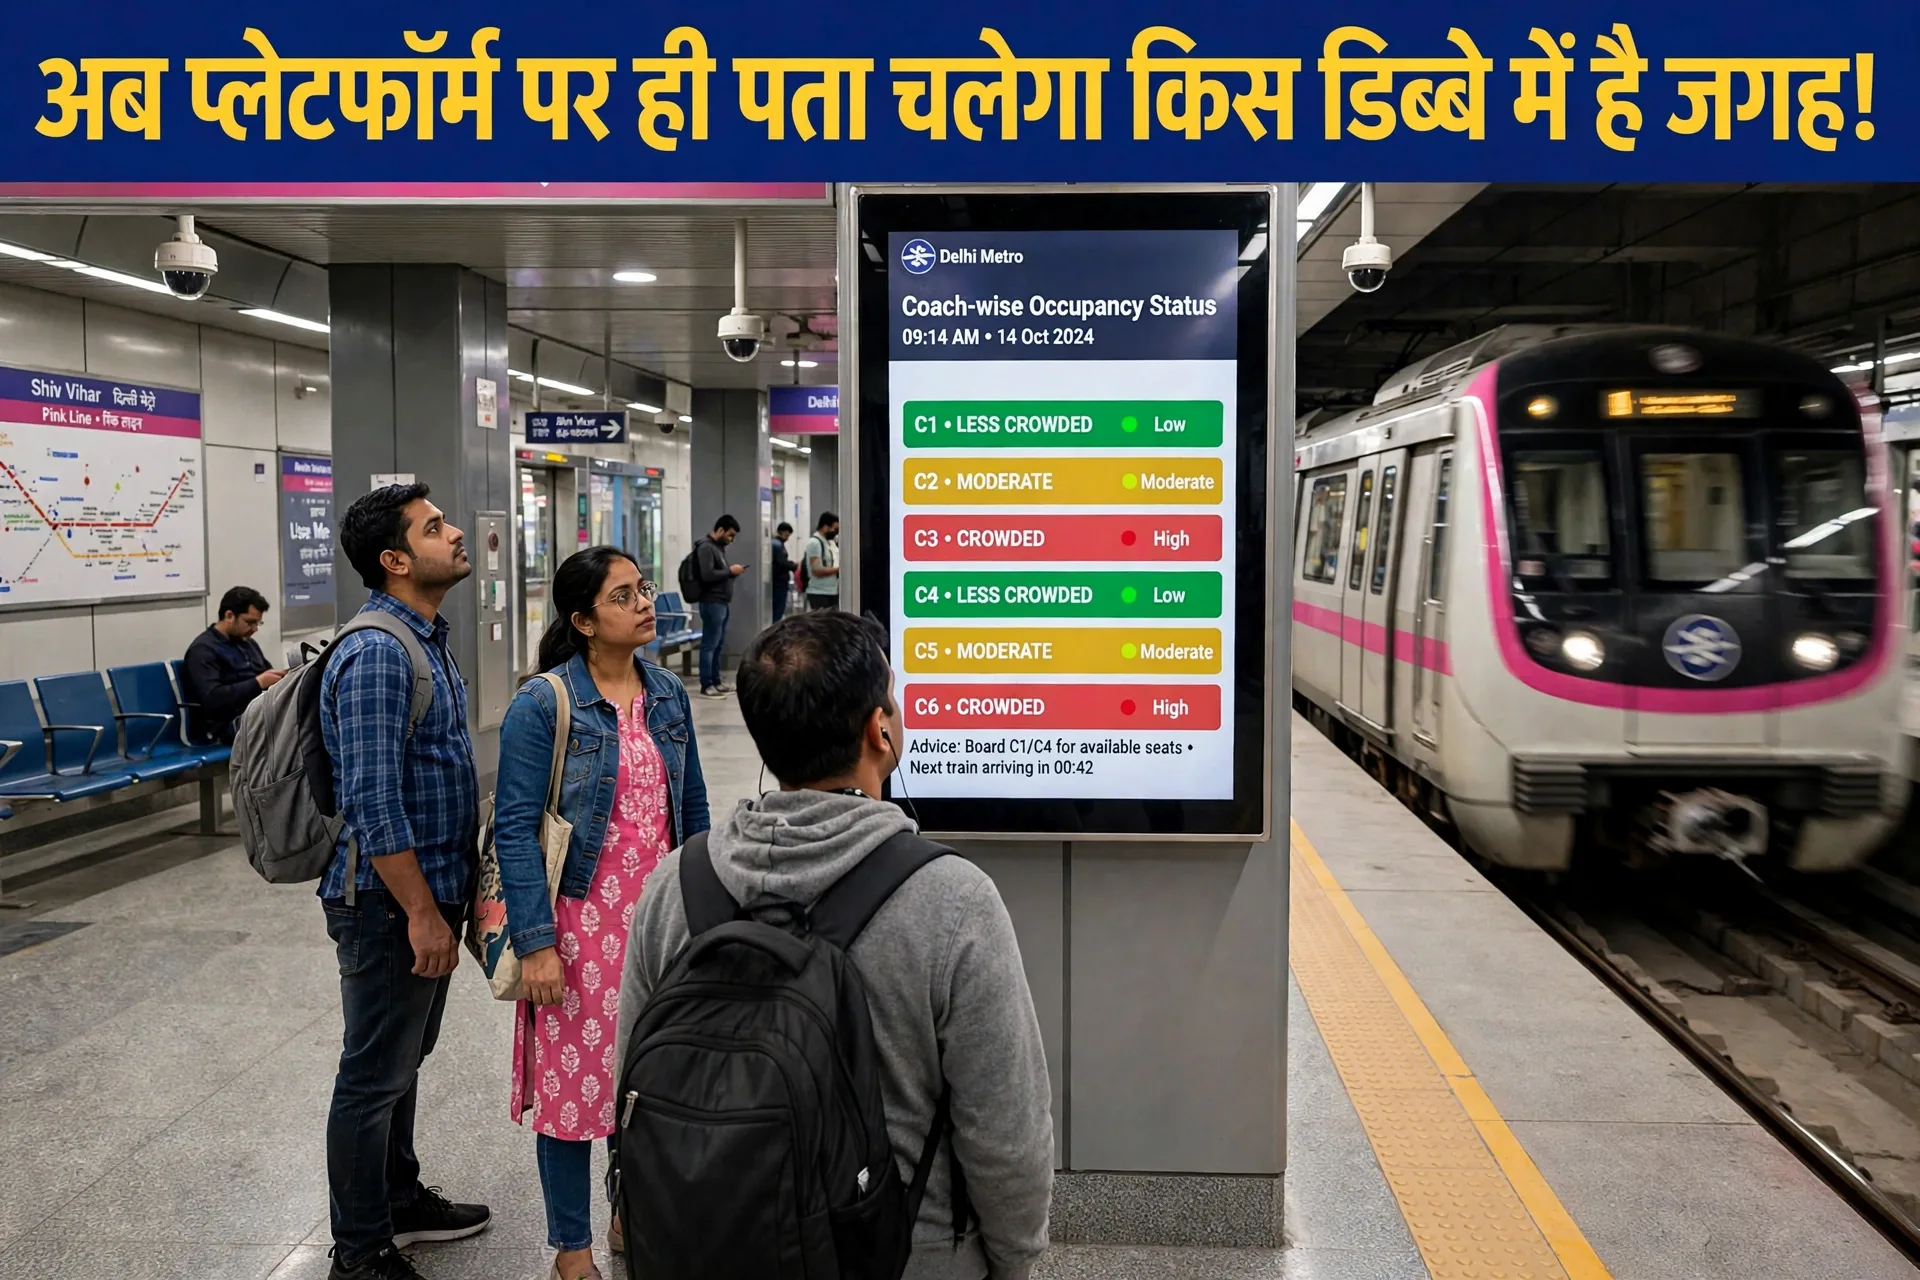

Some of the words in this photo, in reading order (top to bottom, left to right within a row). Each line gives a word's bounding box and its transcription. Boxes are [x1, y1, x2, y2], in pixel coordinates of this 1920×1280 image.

[939, 248, 977, 264] Delhi
[980, 248, 1024, 264] Metro
[902, 294, 1024, 317] Coach-wise
[1029, 295, 1145, 322] Occupancy
[1149, 294, 1218, 316] Status
[902, 328, 949, 345] 09:14
[952, 328, 980, 345] AM
[997, 328, 1018, 345] 14
[1021, 327, 1050, 345] Oct
[1052, 328, 1095, 345] 2024
[31, 378, 62, 398] Shiv
[65, 382, 102, 403] Vihar
[42, 407, 67, 423] Pink
[69, 410, 92, 425] Line
[914, 415, 937, 433] C1
[957, 415, 1000, 433] LESS
[1004, 415, 1093, 433] CROWDED
[1154, 416, 1186, 432] Low
[914, 472, 939, 490] C2
[957, 472, 1053, 490] MODERATE
[1141, 472, 1215, 490] Moderate
[914, 529, 939, 548] C3
[957, 529, 1045, 548] CROWDED
[1153, 529, 1190, 551] High
[915, 586, 939, 604] C4
[957, 586, 1001, 604] LESS
[1004, 586, 1093, 604] CROWDED
[1153, 587, 1186, 603] Low
[914, 642, 938, 660] C5
[957, 642, 1053, 660] MODERATE
[1140, 643, 1214, 660] Moderate
[914, 697, 939, 716] C6
[957, 697, 1045, 716] CROWDED
[1153, 698, 1189, 720] High
[909, 738, 961, 754] Advice:
[965, 738, 1006, 754] Board
[1009, 738, 1052, 755] C1/C4
[1055, 738, 1076, 754] for
[1080, 738, 1141, 755] available
[1145, 740, 1183, 755] seats
[910, 760, 943, 775] Next
[946, 759, 978, 775] train
[982, 759, 1034, 778] arriving
[1037, 760, 1050, 775] in
[1054, 760, 1094, 775] 00:42
